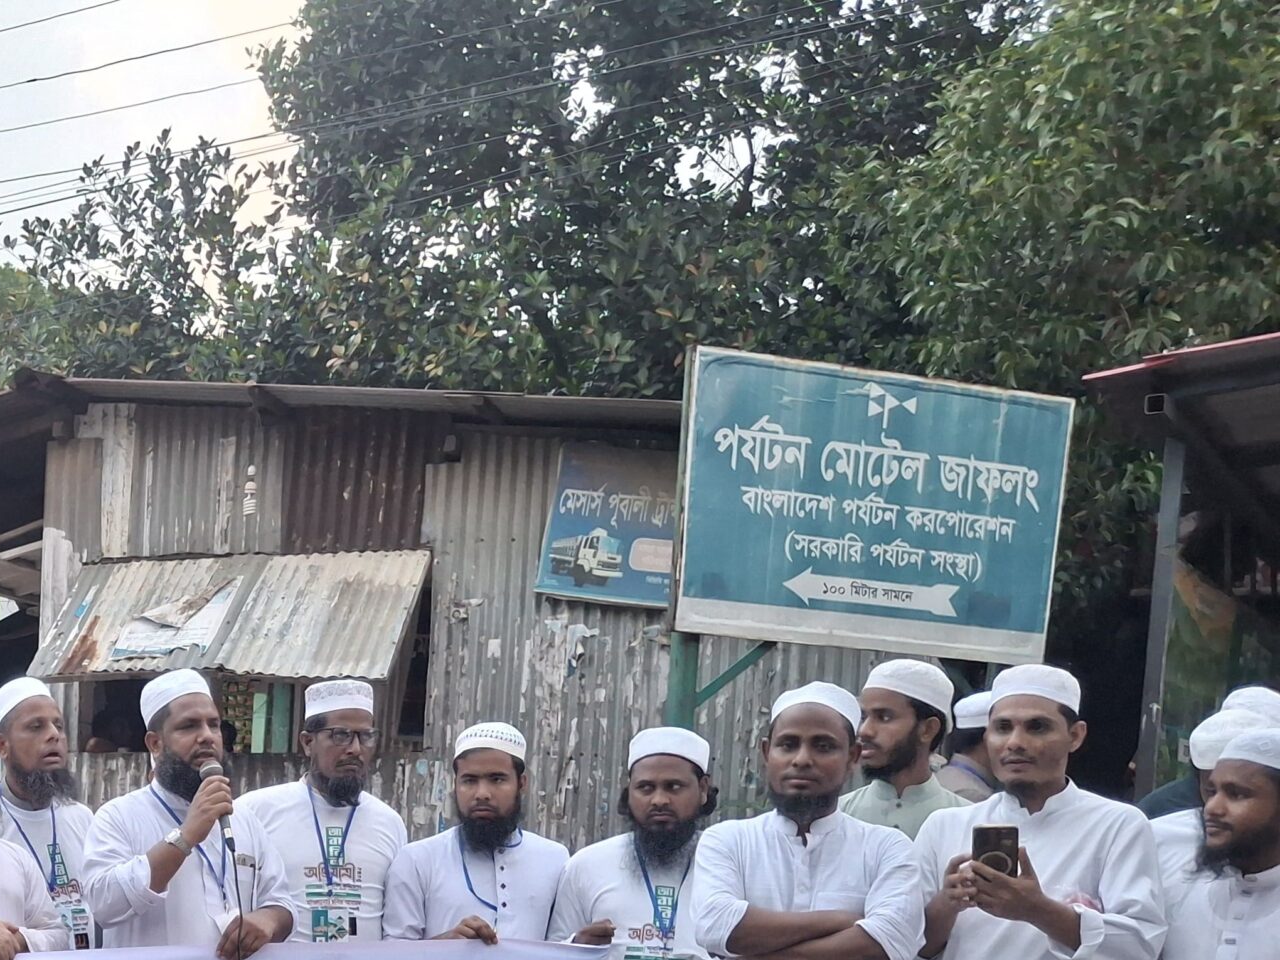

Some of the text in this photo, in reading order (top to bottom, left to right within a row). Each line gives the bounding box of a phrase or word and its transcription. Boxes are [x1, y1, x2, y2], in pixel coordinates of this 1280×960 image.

[714, 415, 1039, 512] পর্যটন মোটেল জাফলং
[560, 482, 608, 518] মেসার্স
[740, 485, 1016, 543] বাংলাদেশ পর্যটন করপোরেশন
[785, 530, 982, 582] (সরকারি পর্যটন সংস্থা)
[822, 581, 914, 602] ১০০ মিটার সামনে
